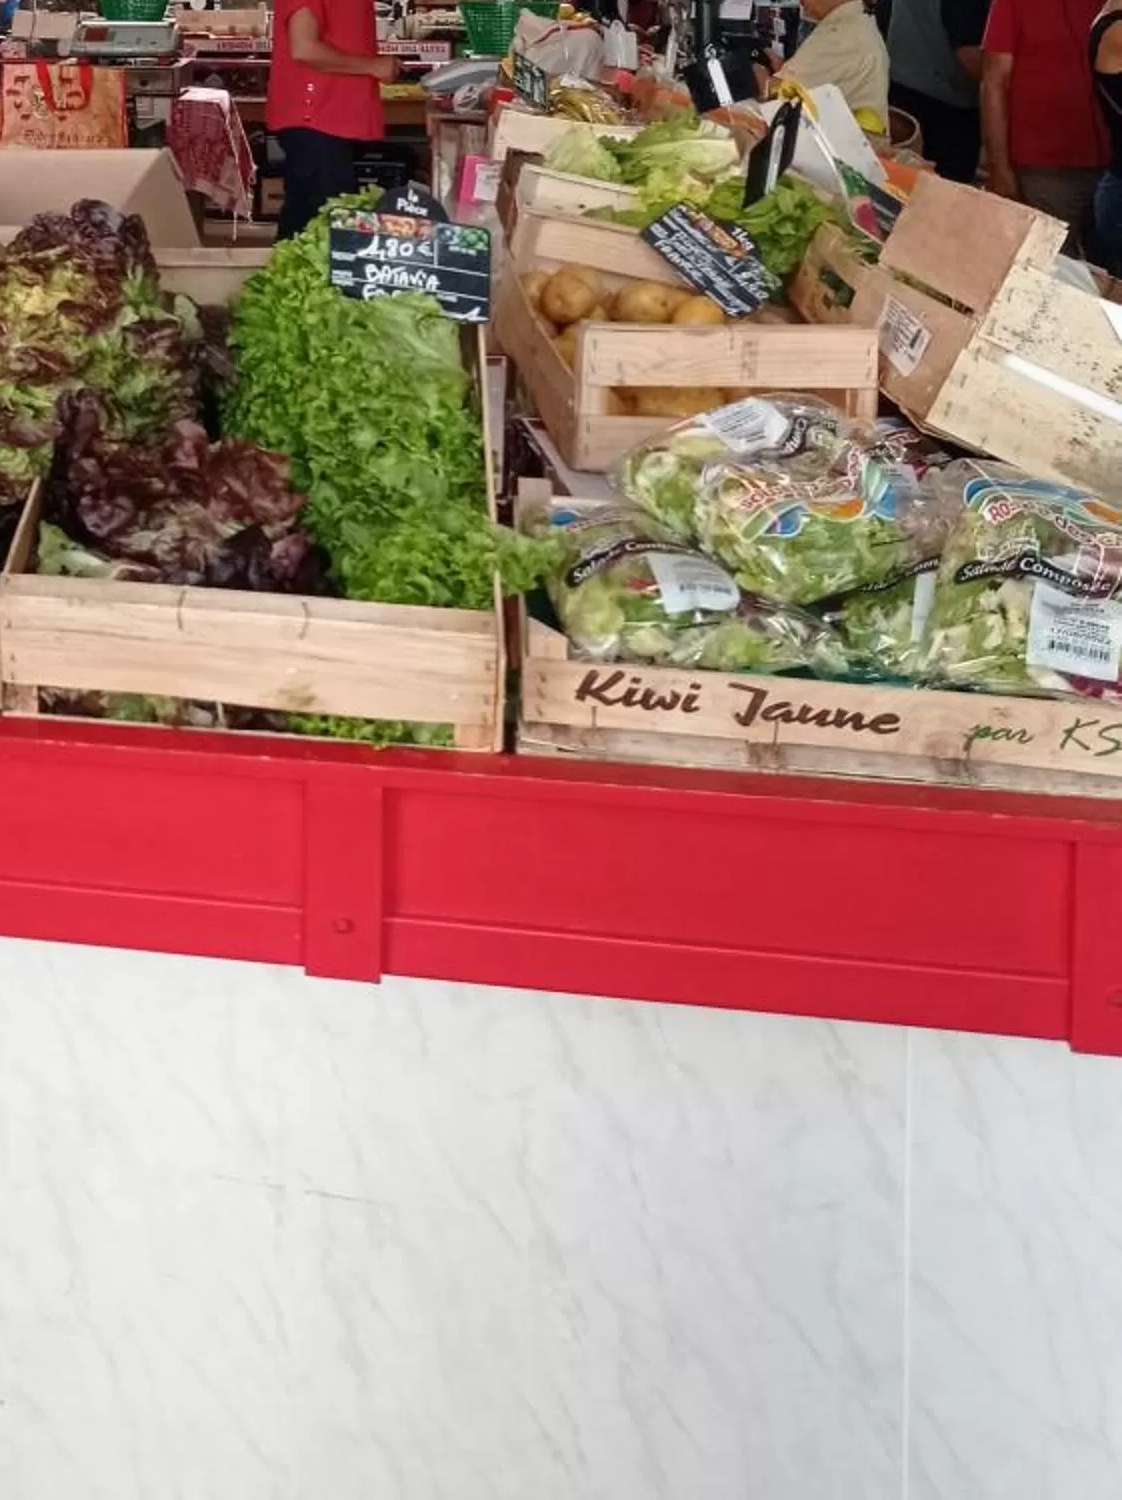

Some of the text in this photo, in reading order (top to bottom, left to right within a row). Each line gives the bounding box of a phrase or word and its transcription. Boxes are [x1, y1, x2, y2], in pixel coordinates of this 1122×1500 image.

[408, 188, 419, 202] la
[396, 198, 428, 217] Pièce
[574, 668, 703, 715] Kiwi
[728, 681, 902, 736] Jaune
[963, 719, 1035, 751] par
